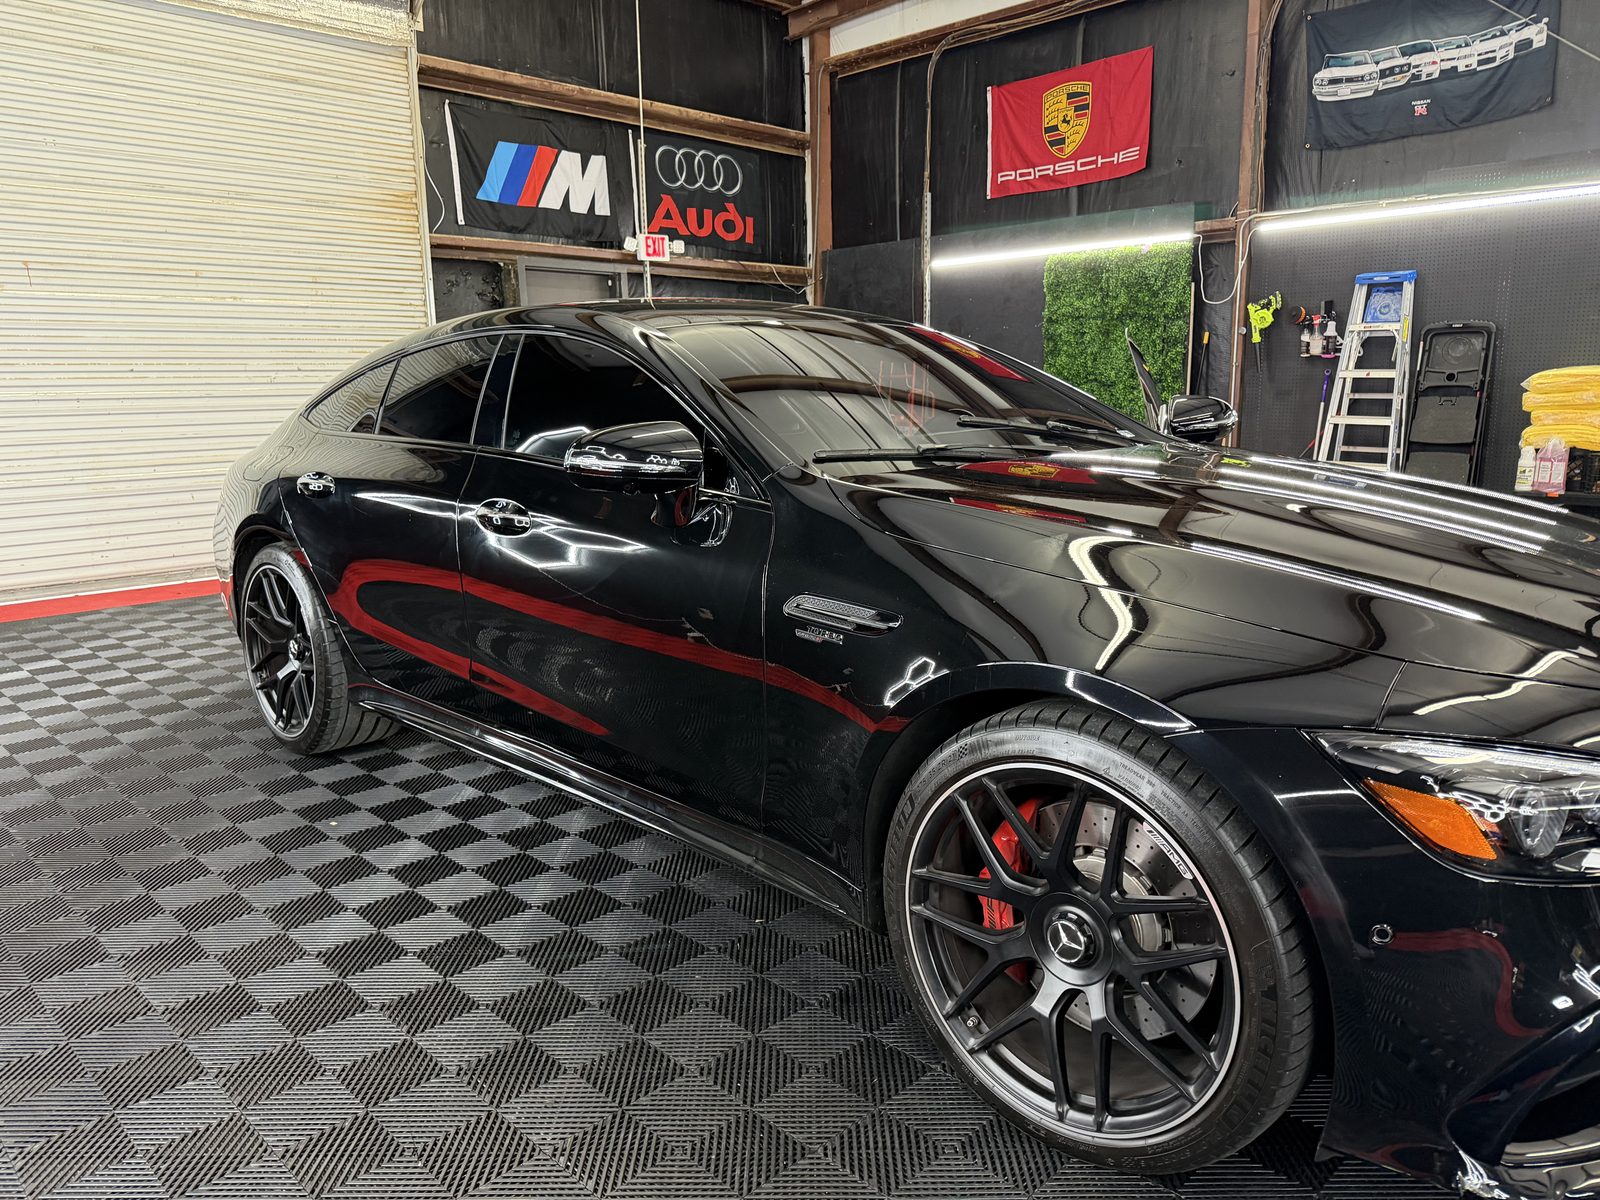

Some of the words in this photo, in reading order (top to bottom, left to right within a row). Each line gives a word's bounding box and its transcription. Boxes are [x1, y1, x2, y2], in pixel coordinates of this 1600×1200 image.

[1045, 84, 1088, 101] PORSCHE
[998, 146, 1140, 184] PORSCHE
[648, 194, 754, 244] Audi
[645, 236, 665, 257] EXIT
